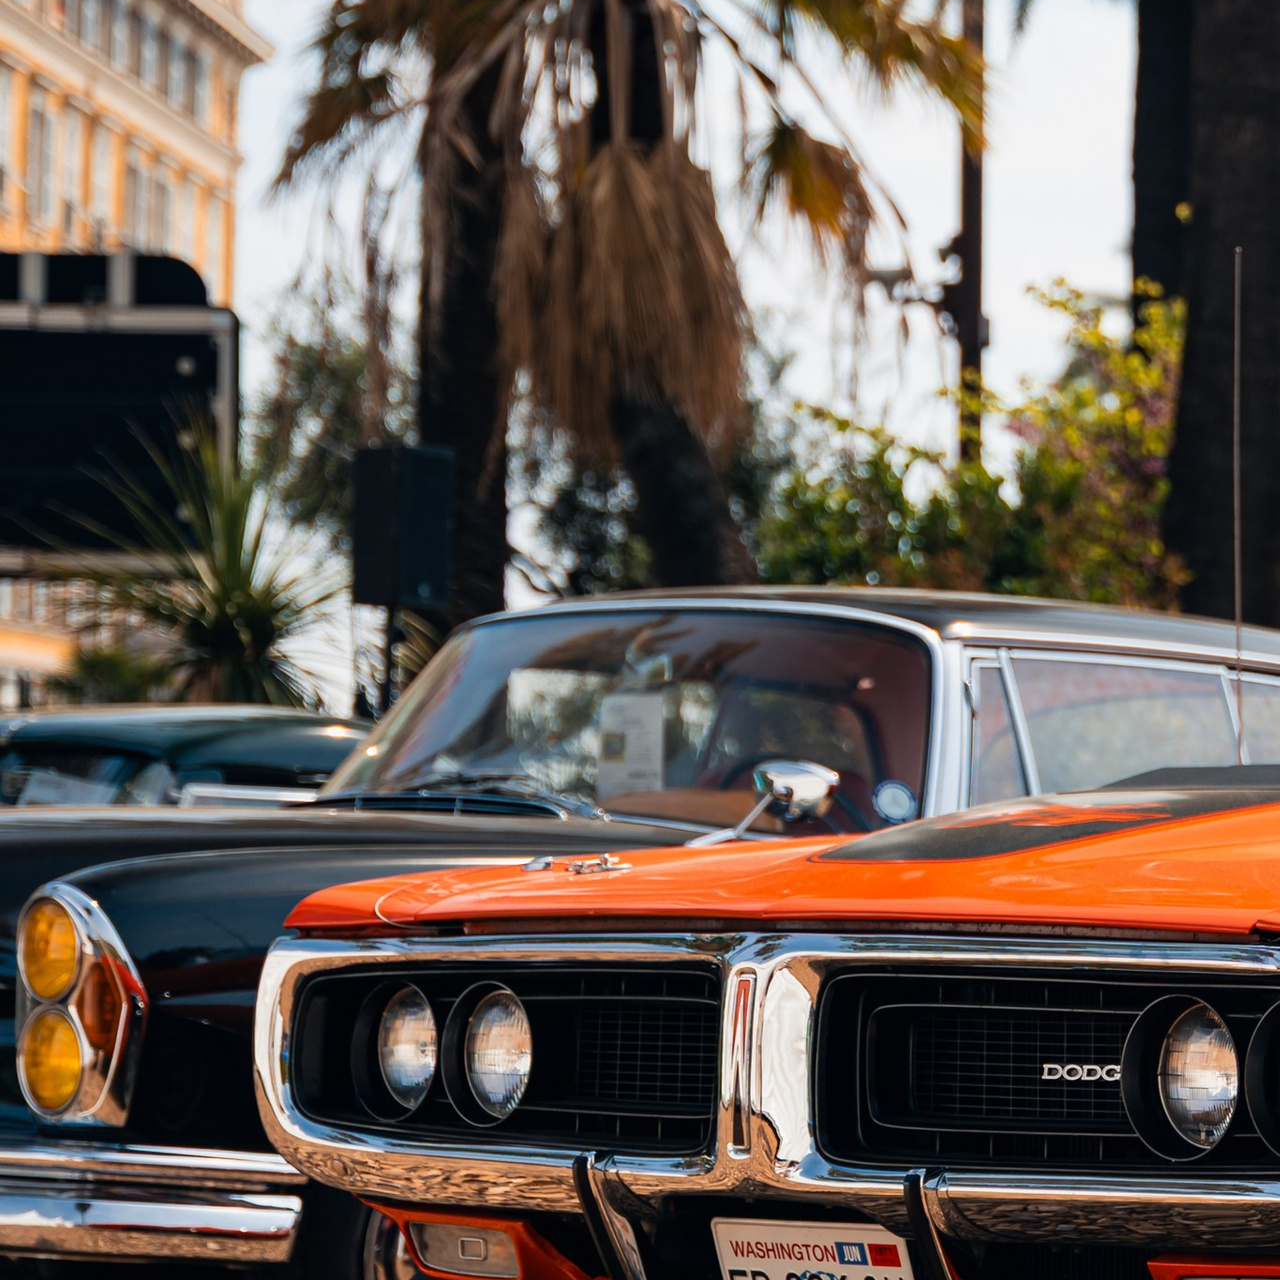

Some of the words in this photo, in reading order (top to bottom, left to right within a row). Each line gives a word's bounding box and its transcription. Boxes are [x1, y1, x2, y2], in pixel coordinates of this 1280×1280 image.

[1042, 1063, 1121, 1081] DODG
[730, 1240, 837, 1263] WASHINGTON
[842, 1245, 862, 1262] JUN
